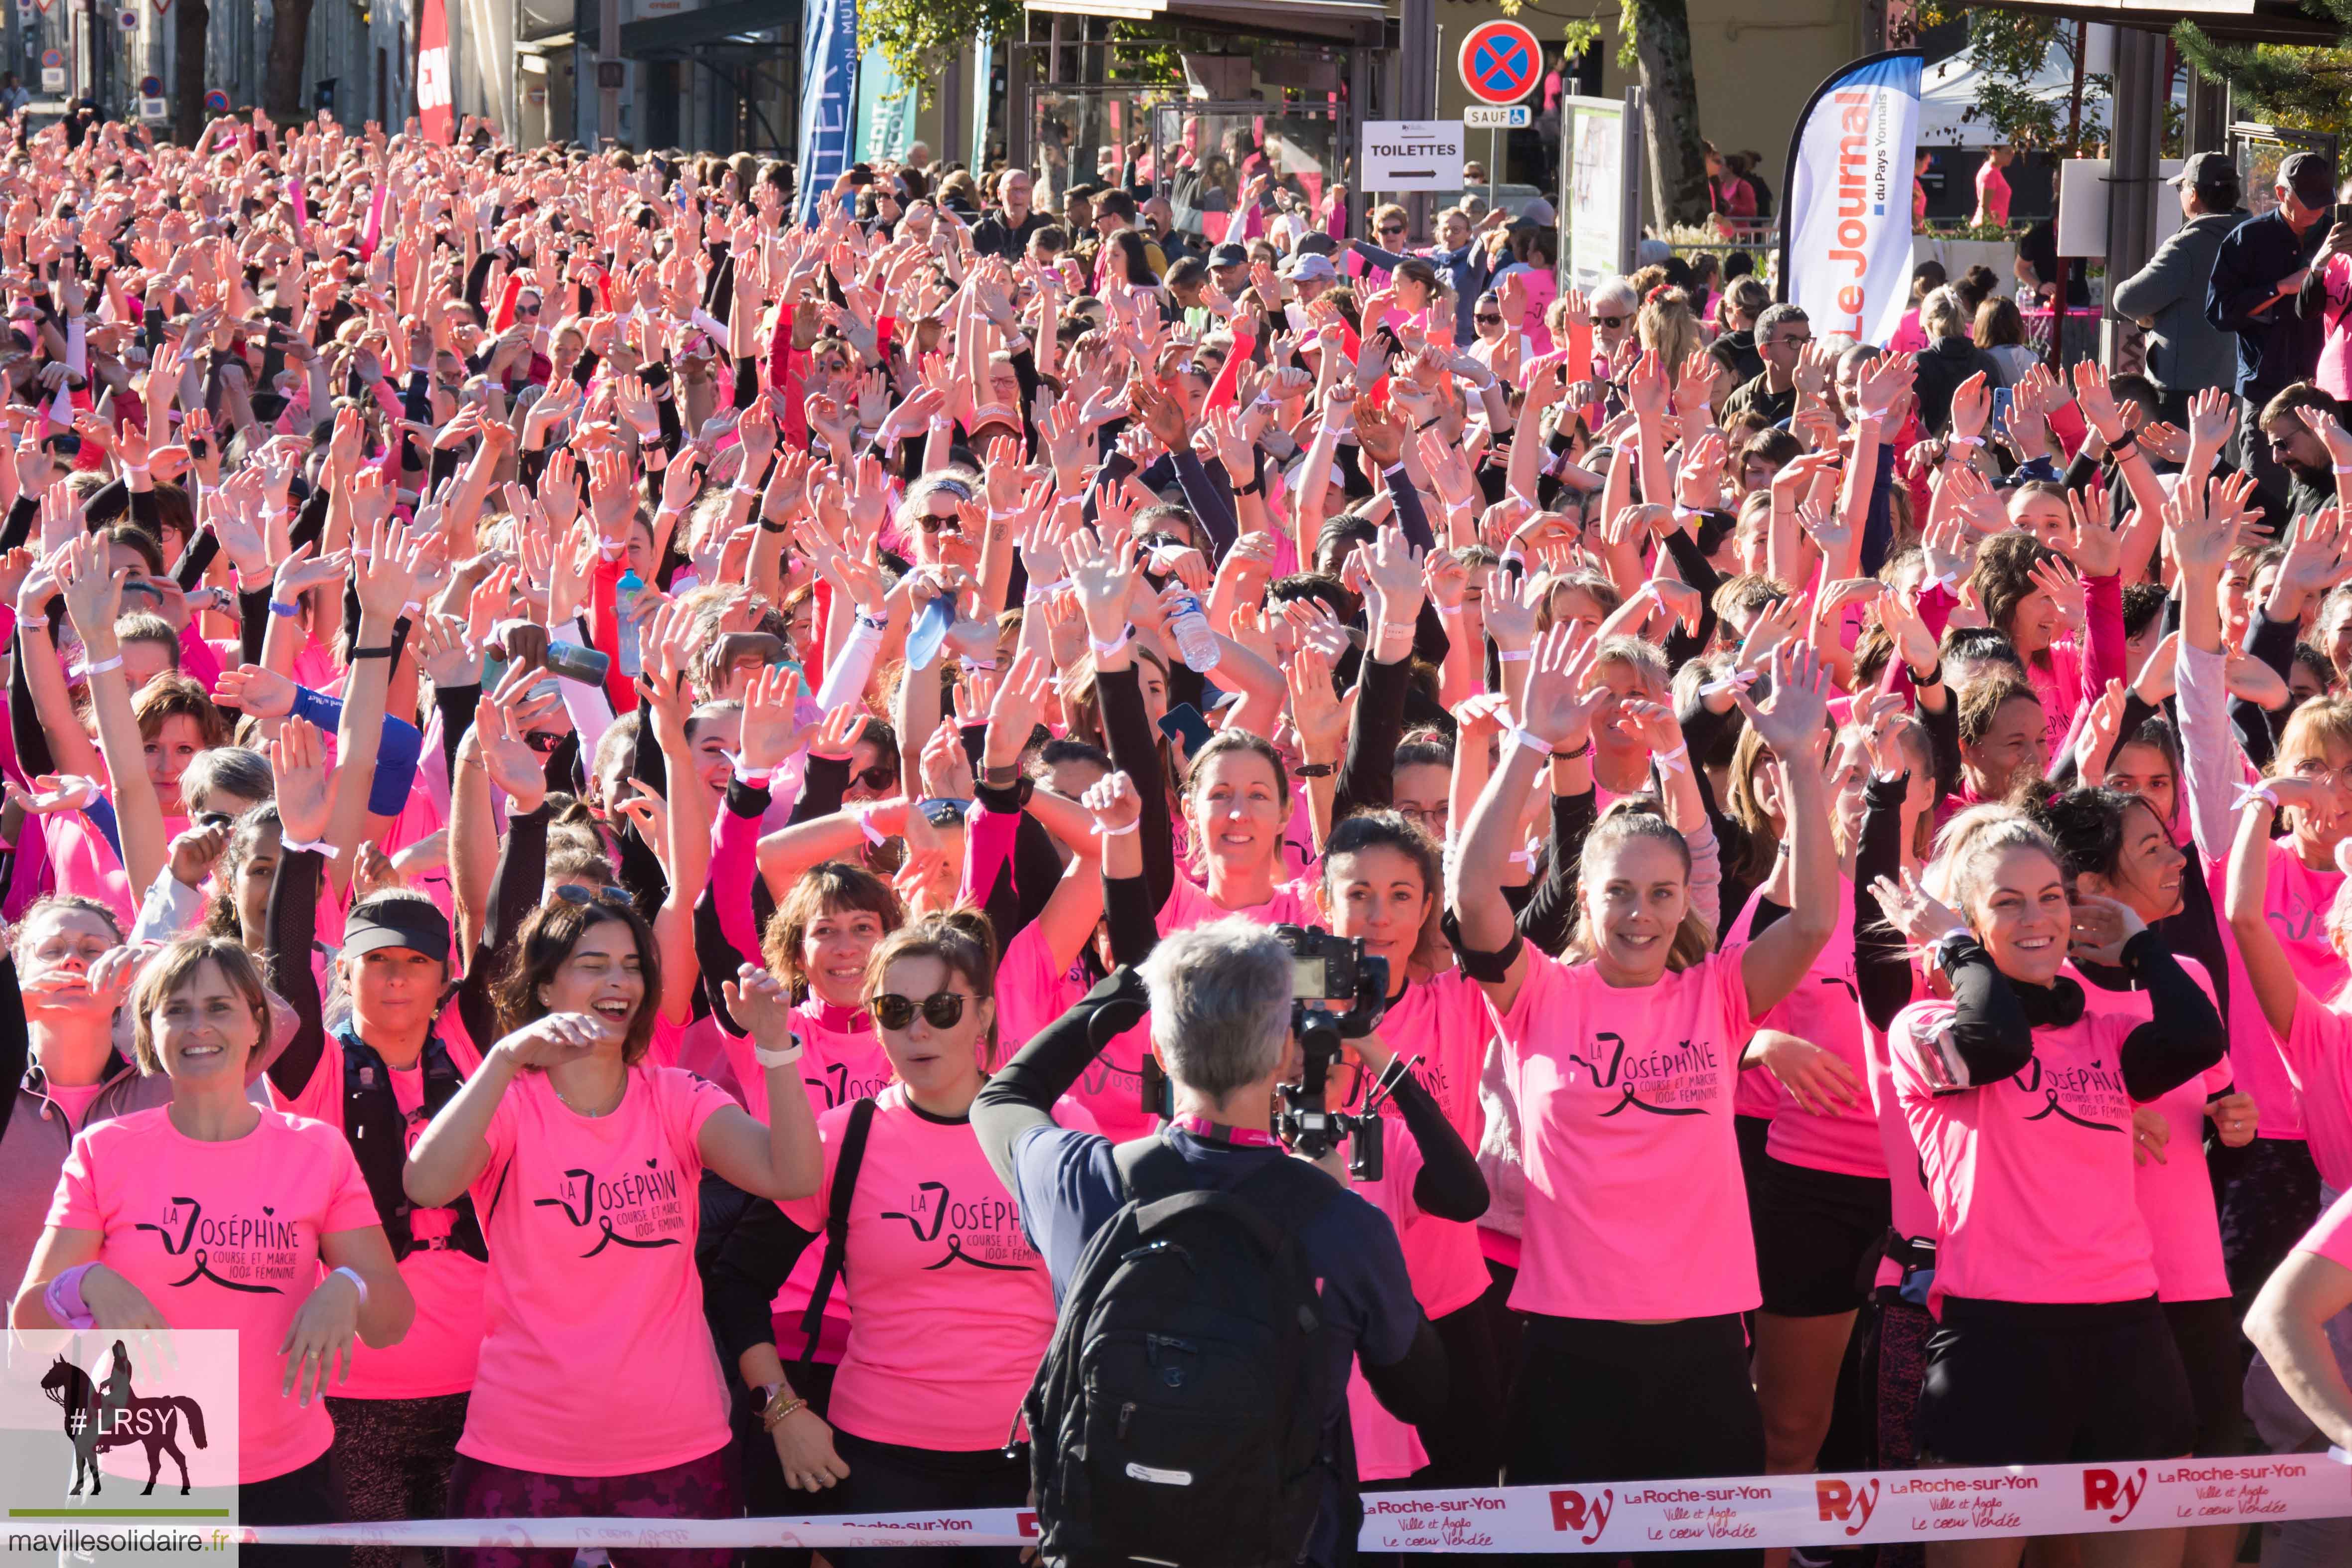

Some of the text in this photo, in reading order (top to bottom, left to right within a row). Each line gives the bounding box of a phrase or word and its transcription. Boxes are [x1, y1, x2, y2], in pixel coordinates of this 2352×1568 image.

[1471, 111, 1507, 123] SAUF
[1371, 145, 1456, 156] TOILETTES
[1875, 94, 1888, 200] du Pays Yonnais
[1829, 93, 1869, 344] Le Journal
[1570, 1032, 1717, 1088] LA JOSÉPHINE
[1640, 1073, 1717, 1092] COURSE ET MARCHE
[1680, 1087, 1717, 1102] FÉMININE
[534, 1169, 677, 1226] LA JOSÉPHIN
[617, 1210, 648, 1225] COURSE
[652, 1206, 660, 1219] ET
[881, 1181, 1020, 1241] LA JOSÉPH
[135, 1197, 298, 1255] LA JOSÉPHINE
[967, 1235, 1001, 1246] COURSE
[1008, 1235, 1017, 1247] ET
[213, 1251, 297, 1265] COURSE ET MARCHE
[256, 1265, 295, 1280] FÉMININE
[2158, 1463, 2306, 1483] La Roche-sur-Yon
[1891, 1475, 2039, 1494] La Roche-sur-Yon
[1625, 1486, 1772, 1504] La Roche-sur-Yon
[2083, 1467, 2147, 1524] Ry
[2196, 1485, 2269, 1504] Ville et Agglo
[1377, 1497, 1506, 1514] Roche-sur-Yon
[1816, 1478, 1879, 1536] Ry
[1929, 1497, 2002, 1517] Ville et Agglo
[2177, 1505, 2192, 1518] Le
[2238, 1500, 2288, 1515] Vendée
[1398, 1516, 1472, 1536] Ville et Agglo
[1549, 1489, 1614, 1545] Ry
[1663, 1506, 1737, 1527] Ville et Agglo
[1912, 1517, 1927, 1530] Le
[1971, 1513, 2021, 1528] Vendée
[1384, 1536, 1398, 1547] Le
[1443, 1532, 1494, 1546] Vendée
[1648, 1527, 1663, 1540] Le
[1707, 1523, 1758, 1539] Vendée
